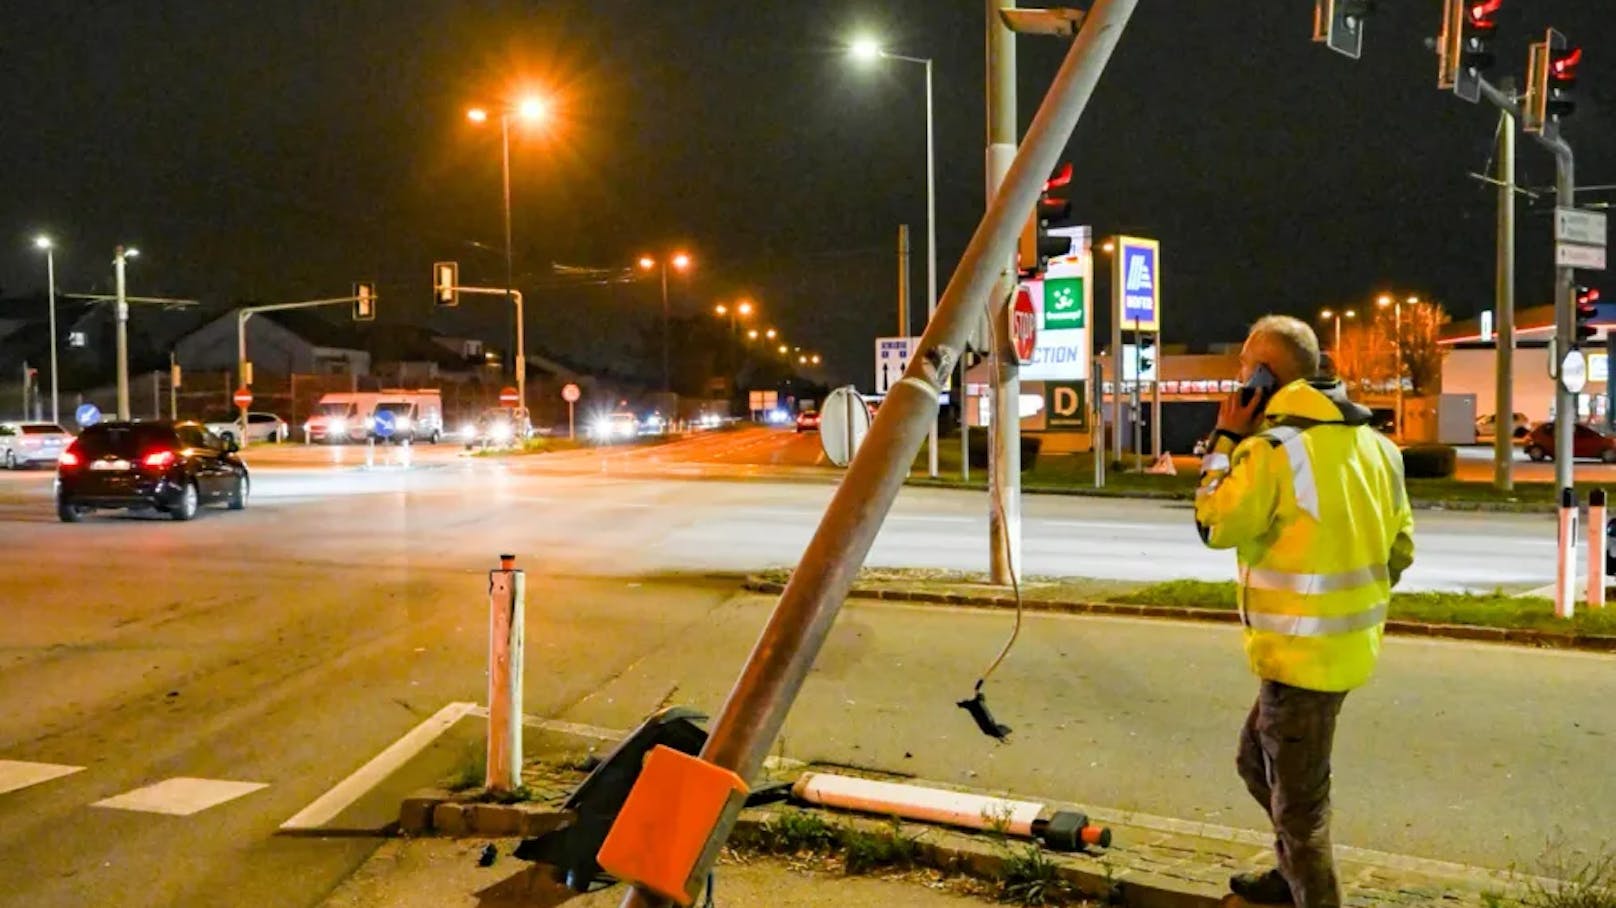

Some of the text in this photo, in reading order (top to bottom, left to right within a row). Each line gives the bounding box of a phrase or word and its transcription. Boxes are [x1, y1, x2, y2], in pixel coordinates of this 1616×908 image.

[1014, 311, 1036, 339] STOP
[1031, 345, 1079, 363] CTION
[1055, 387, 1078, 416] D
